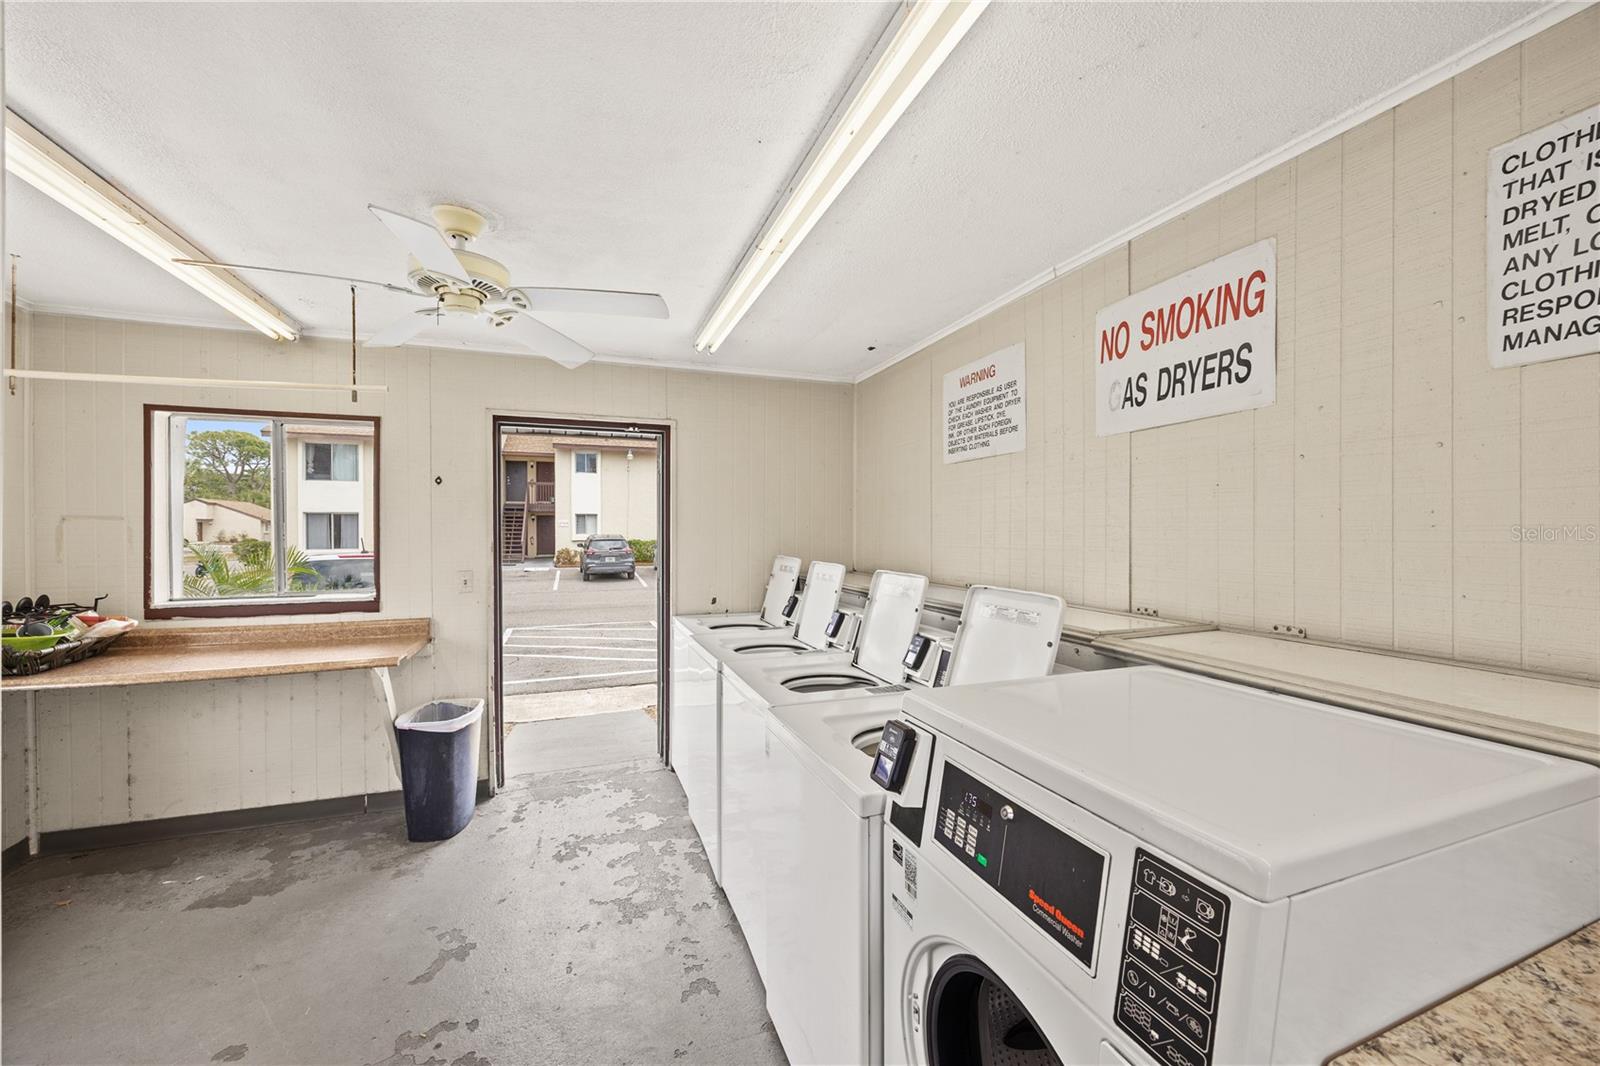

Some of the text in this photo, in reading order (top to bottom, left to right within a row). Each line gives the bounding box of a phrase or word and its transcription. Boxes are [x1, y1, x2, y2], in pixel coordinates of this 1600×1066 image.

[1503, 159, 1573, 200] THAT
[1503, 179, 1597, 226] DRYED
[1503, 214, 1571, 251] MELT,
[1502, 243, 1560, 276] ANY
[1100, 269, 1266, 364] NO SMOKING
[1502, 287, 1600, 327] RESPO
[1502, 314, 1600, 352] MANAG
[959, 364, 996, 389] WARNING
[1156, 341, 1253, 402] DRYERS
[963, 400, 982, 412] LAUNDRY
[983, 391, 1009, 406] EQUIPMENT
[1011, 388, 1018, 397] TO
[966, 387, 994, 402] RESPONSIBLE
[1004, 379, 1017, 390] USER
[974, 405, 992, 417] WASHER
[993, 401, 1003, 410] AND
[974, 429, 998, 441] MATERIALS
[1000, 424, 1019, 436] BEFORE
[991, 417, 1012, 429] FOREIGN
[1029, 889, 1085, 939] Speed Queen
[1033, 903, 1083, 949] Commercial Washer
